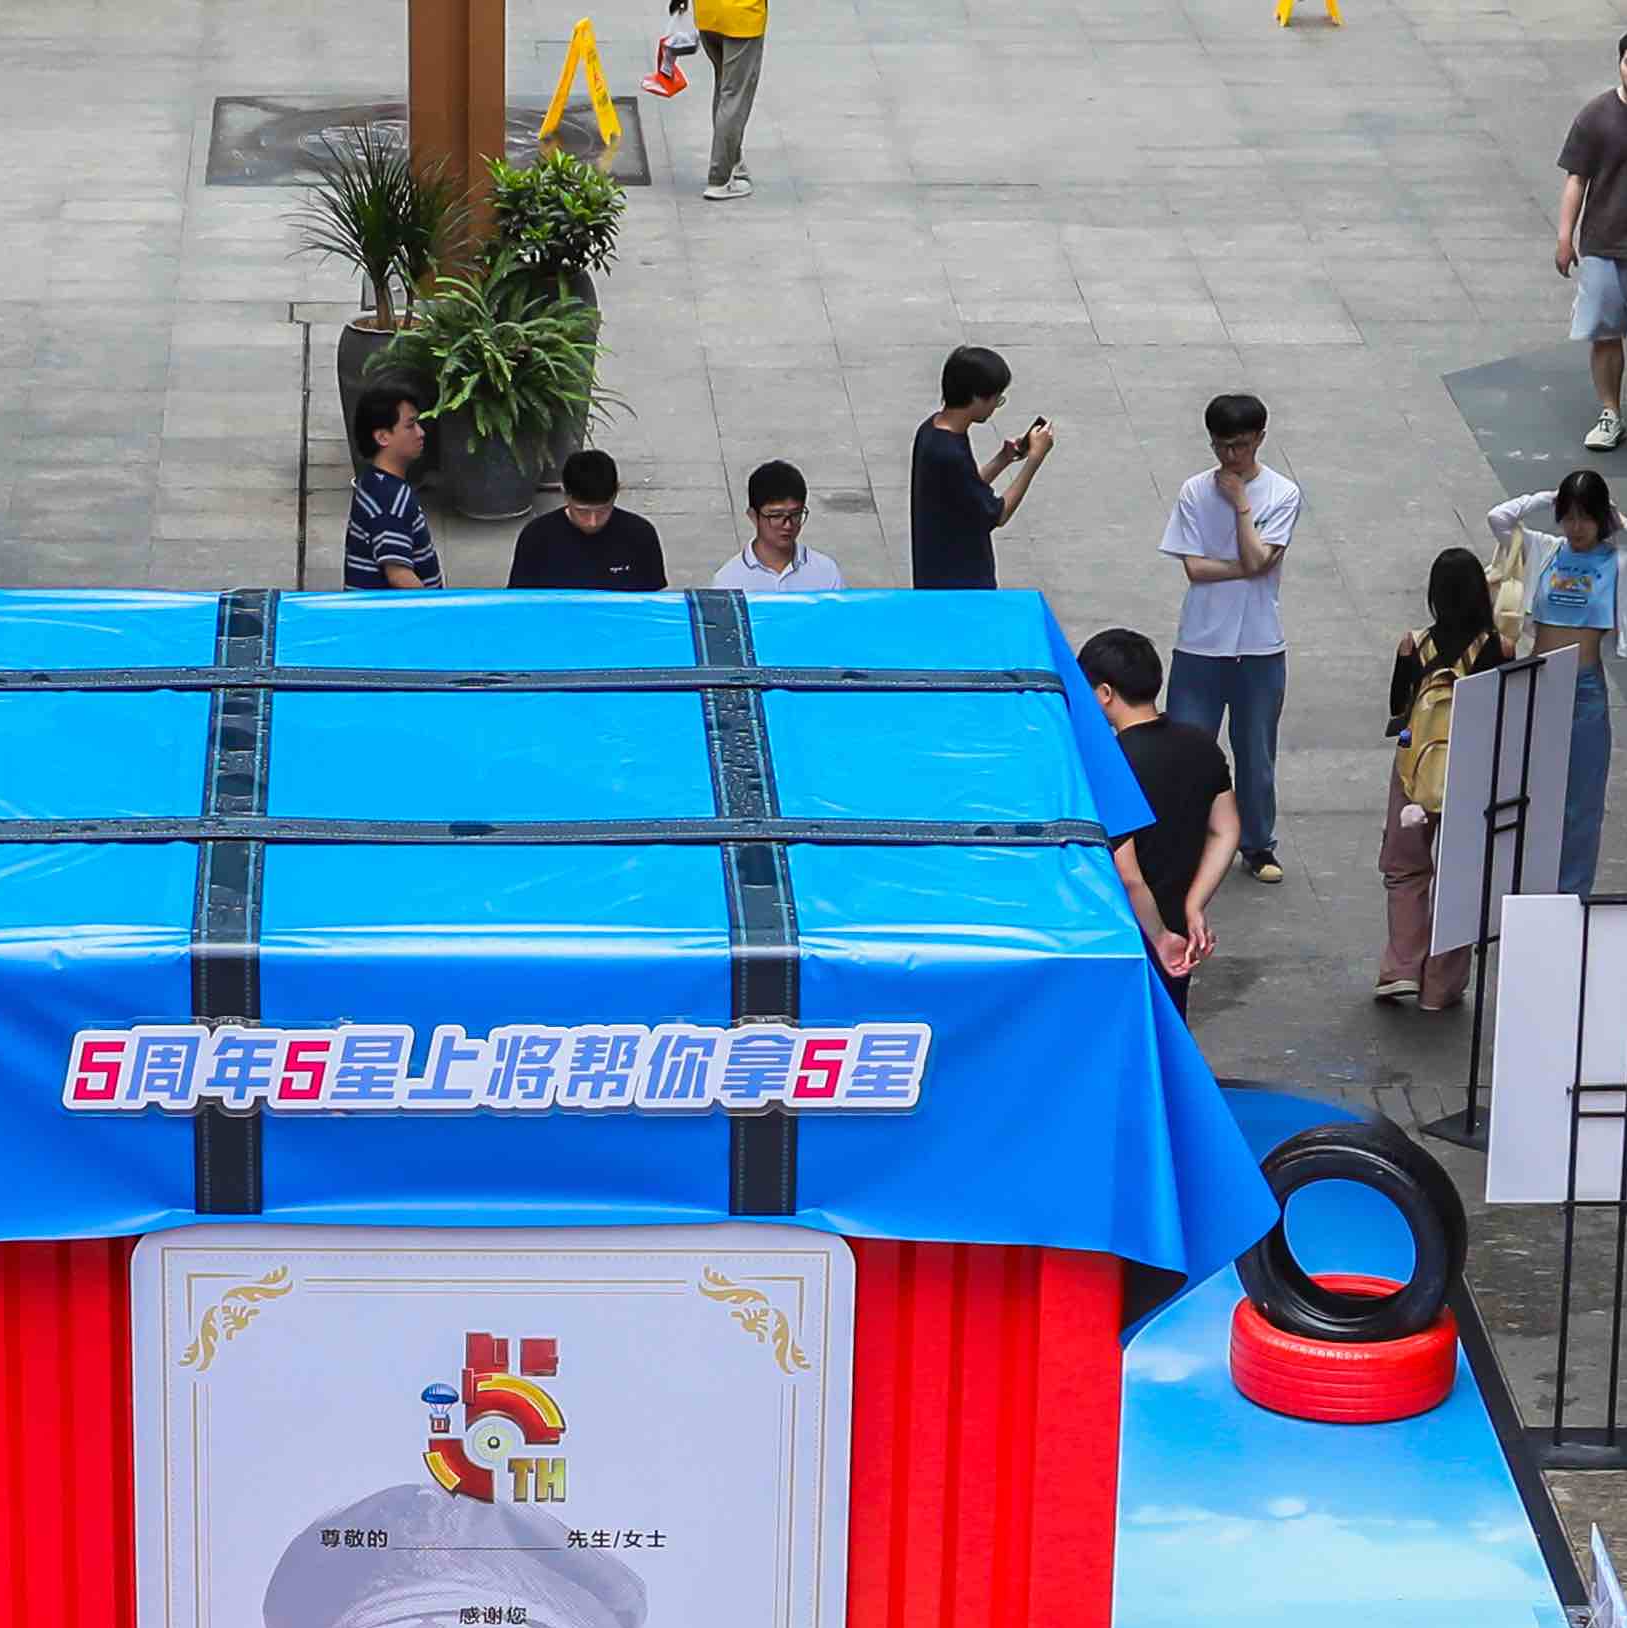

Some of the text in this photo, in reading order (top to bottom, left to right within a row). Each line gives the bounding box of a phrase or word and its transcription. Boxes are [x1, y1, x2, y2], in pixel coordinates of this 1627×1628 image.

[71, 1028, 923, 1102] 5周年5星上将帮你拿5星
[320, 1529, 668, 1550] 尊敬的 先生/女士
[459, 1606, 527, 1626] 感谢您
